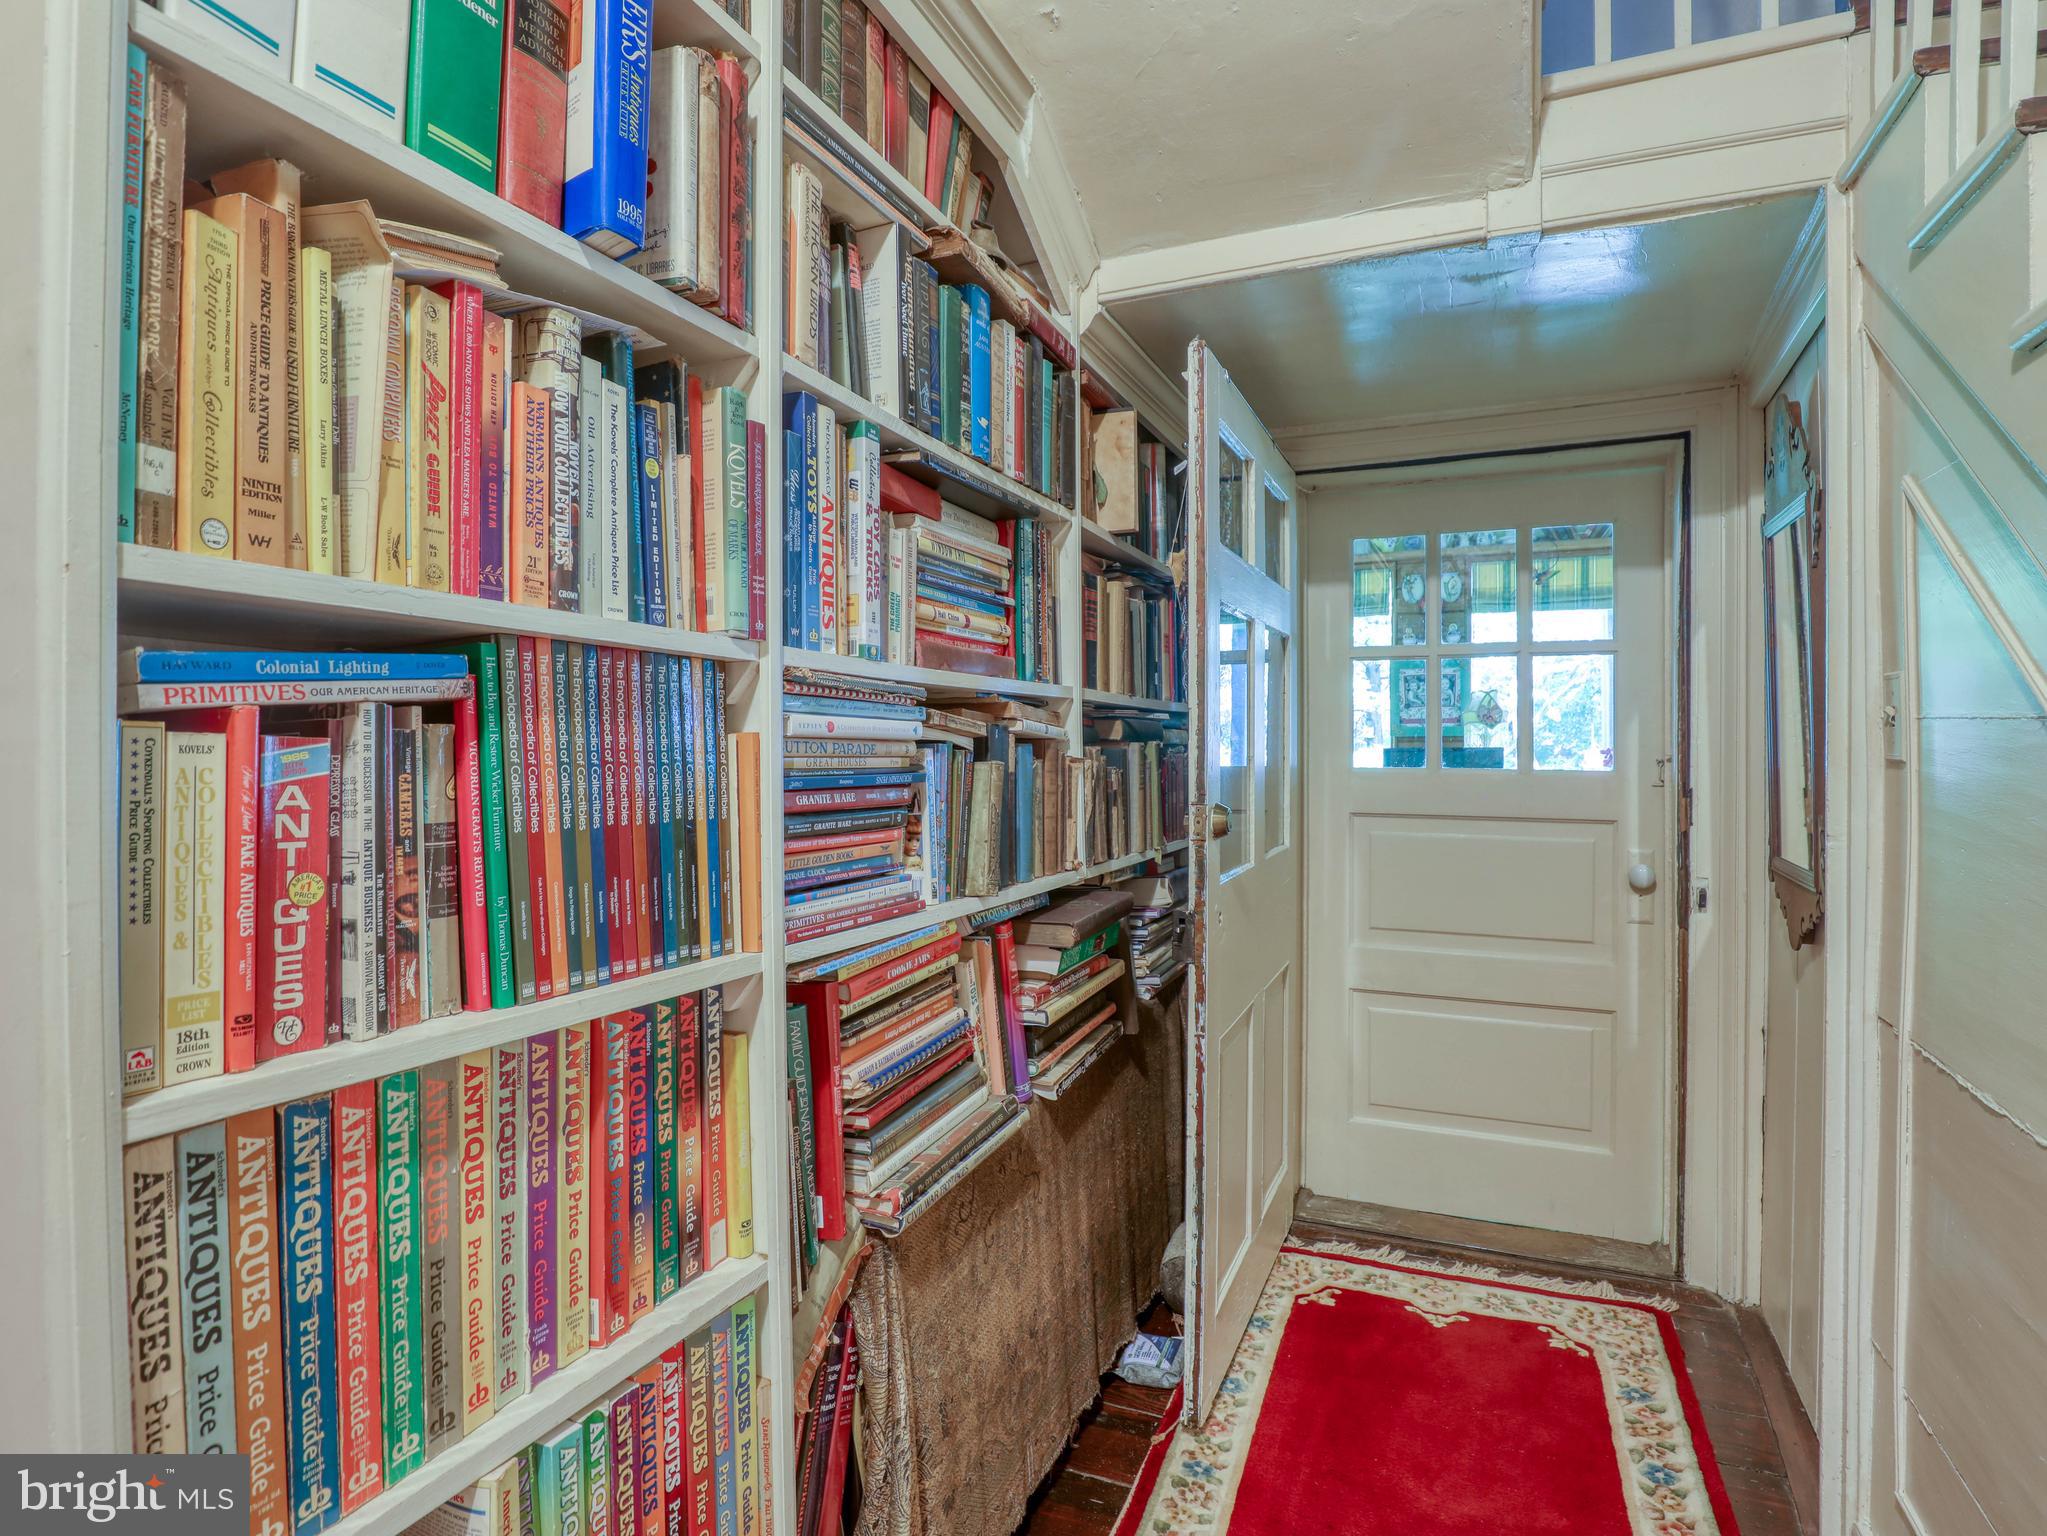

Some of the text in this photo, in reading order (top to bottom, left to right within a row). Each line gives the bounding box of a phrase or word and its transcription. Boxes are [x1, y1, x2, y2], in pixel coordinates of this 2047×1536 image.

[518, 17, 566, 60] MEDICAL
[528, 9, 560, 40] HOME
[518, 34, 565, 73] ADVISER
[129, 67, 144, 110] PINE
[618, 61, 629, 139] PRICE GUIDE
[629, 66, 641, 147] Antiques
[125, 109, 143, 209] FURNITURE
[617, 198, 643, 225] 1995
[124, 235, 135, 280] American
[646, 259, 675, 276] LIBRARIES
[809, 184, 820, 340] THE THORN BIRDS
[121, 283, 134, 331] Heritage
[204, 254, 222, 352] Antiques
[320, 270, 328, 384] METAL LUNCH BOXES
[920, 268, 930, 348] KIPLING
[257, 279, 271, 464] PRICE GUIDE TO ANTIQUES
[118, 391, 131, 444] McNerney
[422, 360, 446, 449] PRICE
[202, 391, 222, 499] Collectibles
[526, 395, 535, 528] AND THEIR PRICES
[610, 423, 618, 458] Kovels'
[242, 476, 281, 494] NINTH
[426, 453, 441, 519] GUIDE
[534, 401, 544, 549] WARMAN'S ANTIQUES
[554, 372, 570, 564] KNOW YOUR COLLECTIBLES
[586, 444, 595, 519] Advertising
[610, 460, 618, 506] Complete
[727, 442, 747, 513] KOVELS'
[807, 457, 817, 513] TOYS
[868, 452, 877, 501] Collecting
[242, 488, 282, 504] EDITION
[248, 508, 276, 520] Miller
[610, 509, 618, 554] Antiques
[728, 519, 738, 560] OF MARKS
[611, 556, 619, 578] Price
[819, 495, 835, 630] ANTIQUES
[558, 590, 578, 600] CROWN
[256, 656, 321, 675] Colonial
[328, 655, 390, 676] Lighting
[163, 683, 440, 706] PRIMITIVES OUR AMERICAN HERITAGE
[363, 709, 372, 727] HOW
[178, 744, 215, 756] KOVELS'
[363, 731, 372, 740] TO
[364, 744, 372, 753] BE
[504, 648, 524, 834] The Encyclopedia of Collectibles
[832, 742, 878, 756] PARADE
[364, 756, 372, 802] SUCCESSFUL
[805, 757, 867, 768] GREAT HOUSES
[330, 755, 341, 837] DEPRESSION GLASS
[364, 806, 372, 814] IN
[398, 774, 412, 837] CAMERAS
[796, 792, 856, 806] GRANITE WARE
[364, 818, 372, 832] THE
[468, 740, 484, 906] VICTORIAN CRAFTS REVIVED
[484, 657, 510, 991] How to Buy and Restore Wicker Furniture by Thomas Duncan
[363, 839, 373, 882] ANTIQUE
[811, 855, 836, 867] GOLDEN
[836, 851, 854, 862] BOOKS
[236, 834, 254, 937] FAKE ANTIQUES
[364, 886, 373, 933] BUSINESS
[970, 903, 1009, 928] ANTIQUES
[365, 950, 373, 987] SURVIVAL
[377, 954, 386, 1012] JANUARY 1983
[887, 952, 931, 980] COOKIE JARS
[365, 991, 374, 1032] HANDBOOK
[176, 1030, 210, 1046] 18th
[176, 1041, 210, 1054] Edition
[788, 1020, 807, 1096] FAMILY GUIDE
[176, 1058, 212, 1074] CROWN
[654, 1003, 674, 1144] ANTIQUES
[527, 1042, 548, 1189] ANTIQUES
[706, 988, 722, 1216] ANTIQUES Price Guide
[216, 1151, 224, 1198] Schroeder's
[384, 1090, 410, 1262] ANTIQUES
[460, 1063, 488, 1360] ANTIQUES Price Guide
[131, 1172, 171, 1383] ANTIQUES
[186, 1151, 222, 1437] ANTIQUES Price
[290, 1115, 326, 1462] ANTIQUES Price Guide
[338, 1106, 372, 1442] ANTIQUES Price Guide
[235, 1136, 274, 1496] ANTIQUES Price Guide
[711, 1332, 729, 1456] ANTIQUES
[734, 1313, 752, 1481] ANTIQUES Price
[661, 1361, 681, 1493] ANTIQUES
